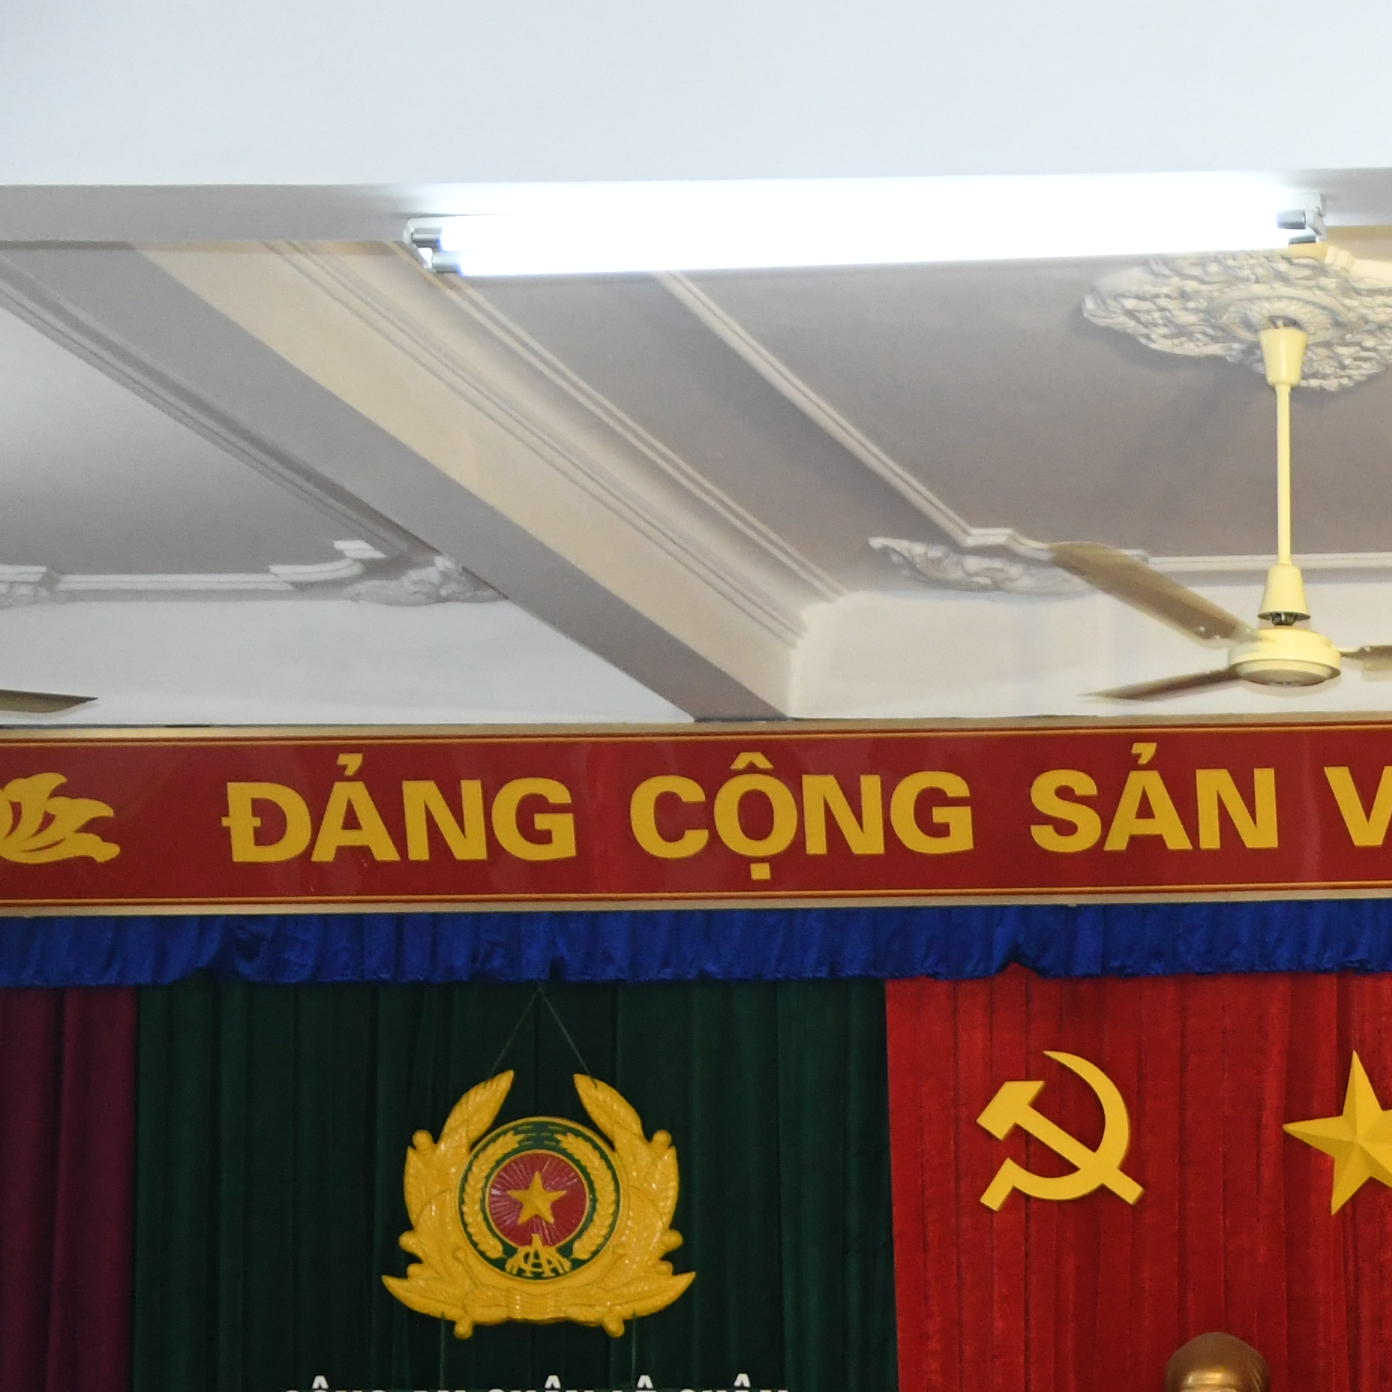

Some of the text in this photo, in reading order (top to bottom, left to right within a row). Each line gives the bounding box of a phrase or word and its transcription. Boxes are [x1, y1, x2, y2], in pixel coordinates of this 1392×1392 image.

[221, 753, 577, 862] ĐẢNG
[630, 752, 975, 880] CỘNG
[1030, 742, 1279, 854] SẢN
